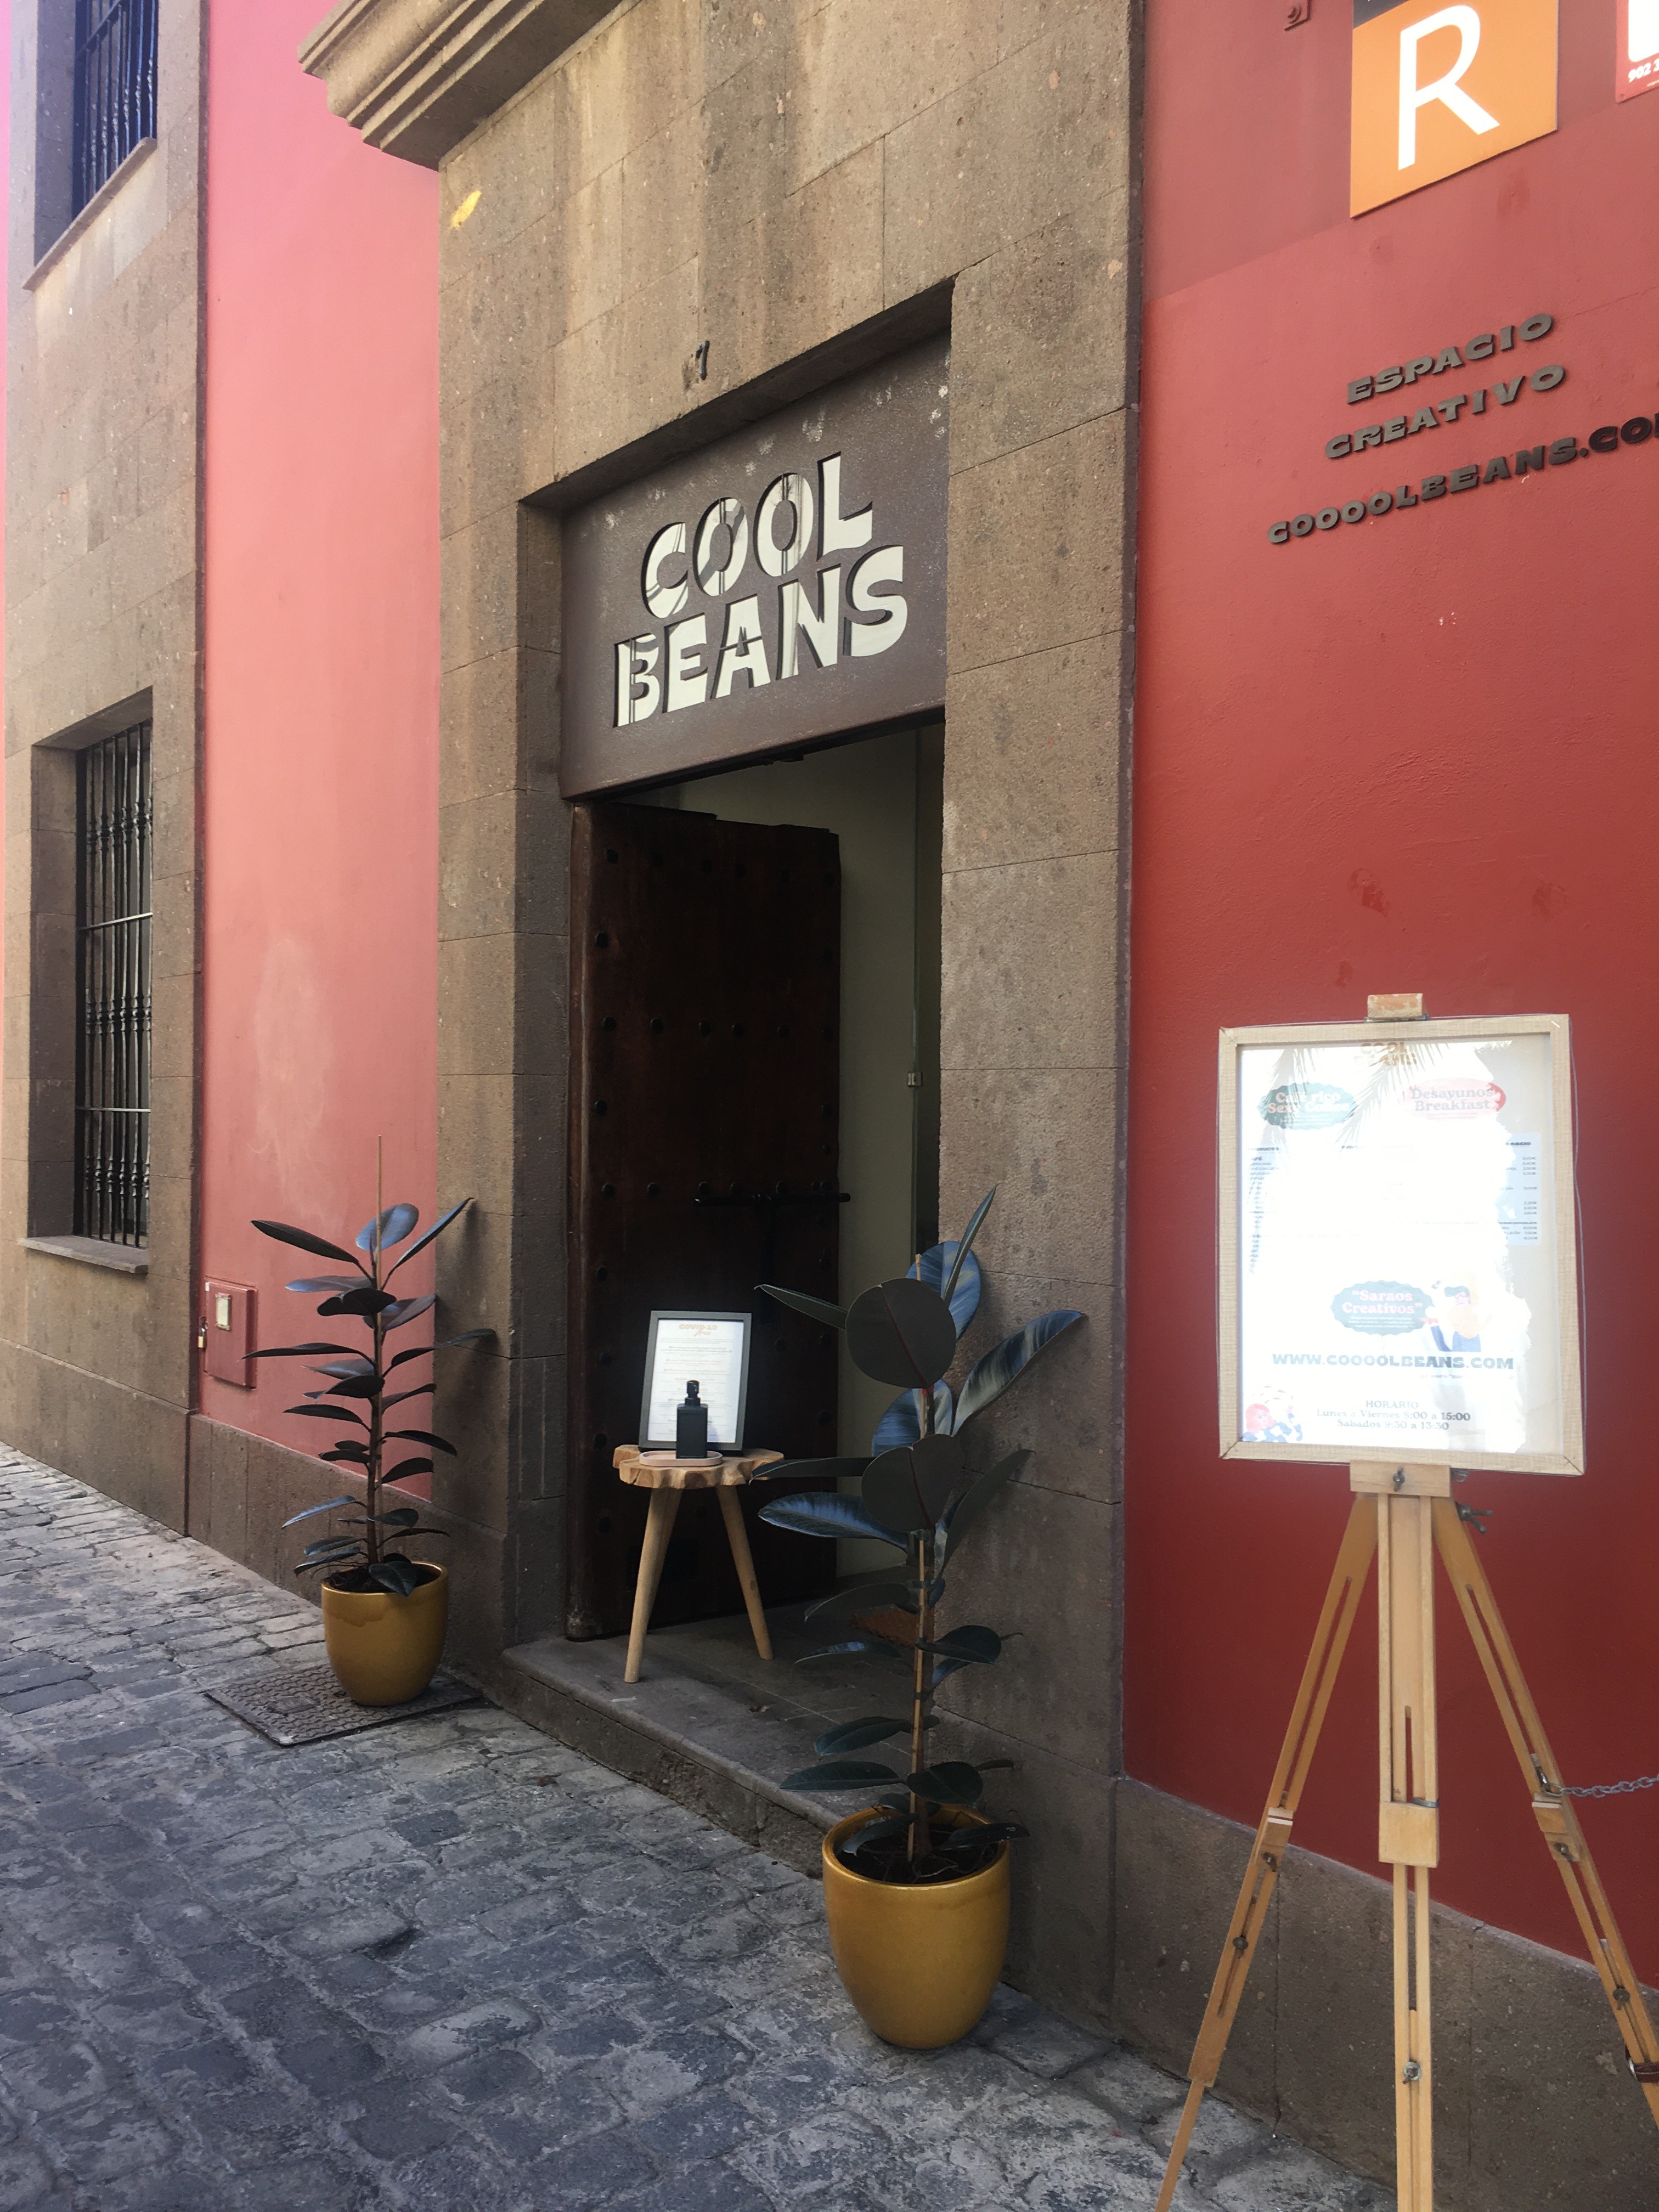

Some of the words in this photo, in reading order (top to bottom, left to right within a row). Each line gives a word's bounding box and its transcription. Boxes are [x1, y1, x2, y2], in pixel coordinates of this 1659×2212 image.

[1628, 63, 1651, 83] 902
[1398, 4, 1500, 171] R
[1346, 313, 1556, 405] ESPACIO
[1324, 364, 1567, 460] CREATIVO
[1267, 413, 1659, 546] COOOOLBEANS.CO
[641, 451, 873, 619] COOL
[613, 544, 908, 727] BEANS
[1276, 1092, 1307, 1103] Café
[1311, 1091, 1341, 1102] rico
[1411, 1087, 1494, 1101] Desayunos
[1415, 1099, 1492, 1111] Breakfast
[1352, 1290, 1413, 1301] “Saraos
[1342, 1302, 1423, 1314] Creativos”
[1272, 1353, 1514, 1370] WWW.COOOOLBEANS.COM
[1365, 1400, 1419, 1409] HORARIO
[1317, 1409, 1347, 1417] Lunes
[1361, 1410, 1400, 1419] Viernes
[1441, 1412, 1471, 1421] 15:00
[1338, 1420, 1381, 1429] Sabados
[1384, 1421, 1408, 1429] 9:30
[1420, 1421, 1450, 1430] 13:30
